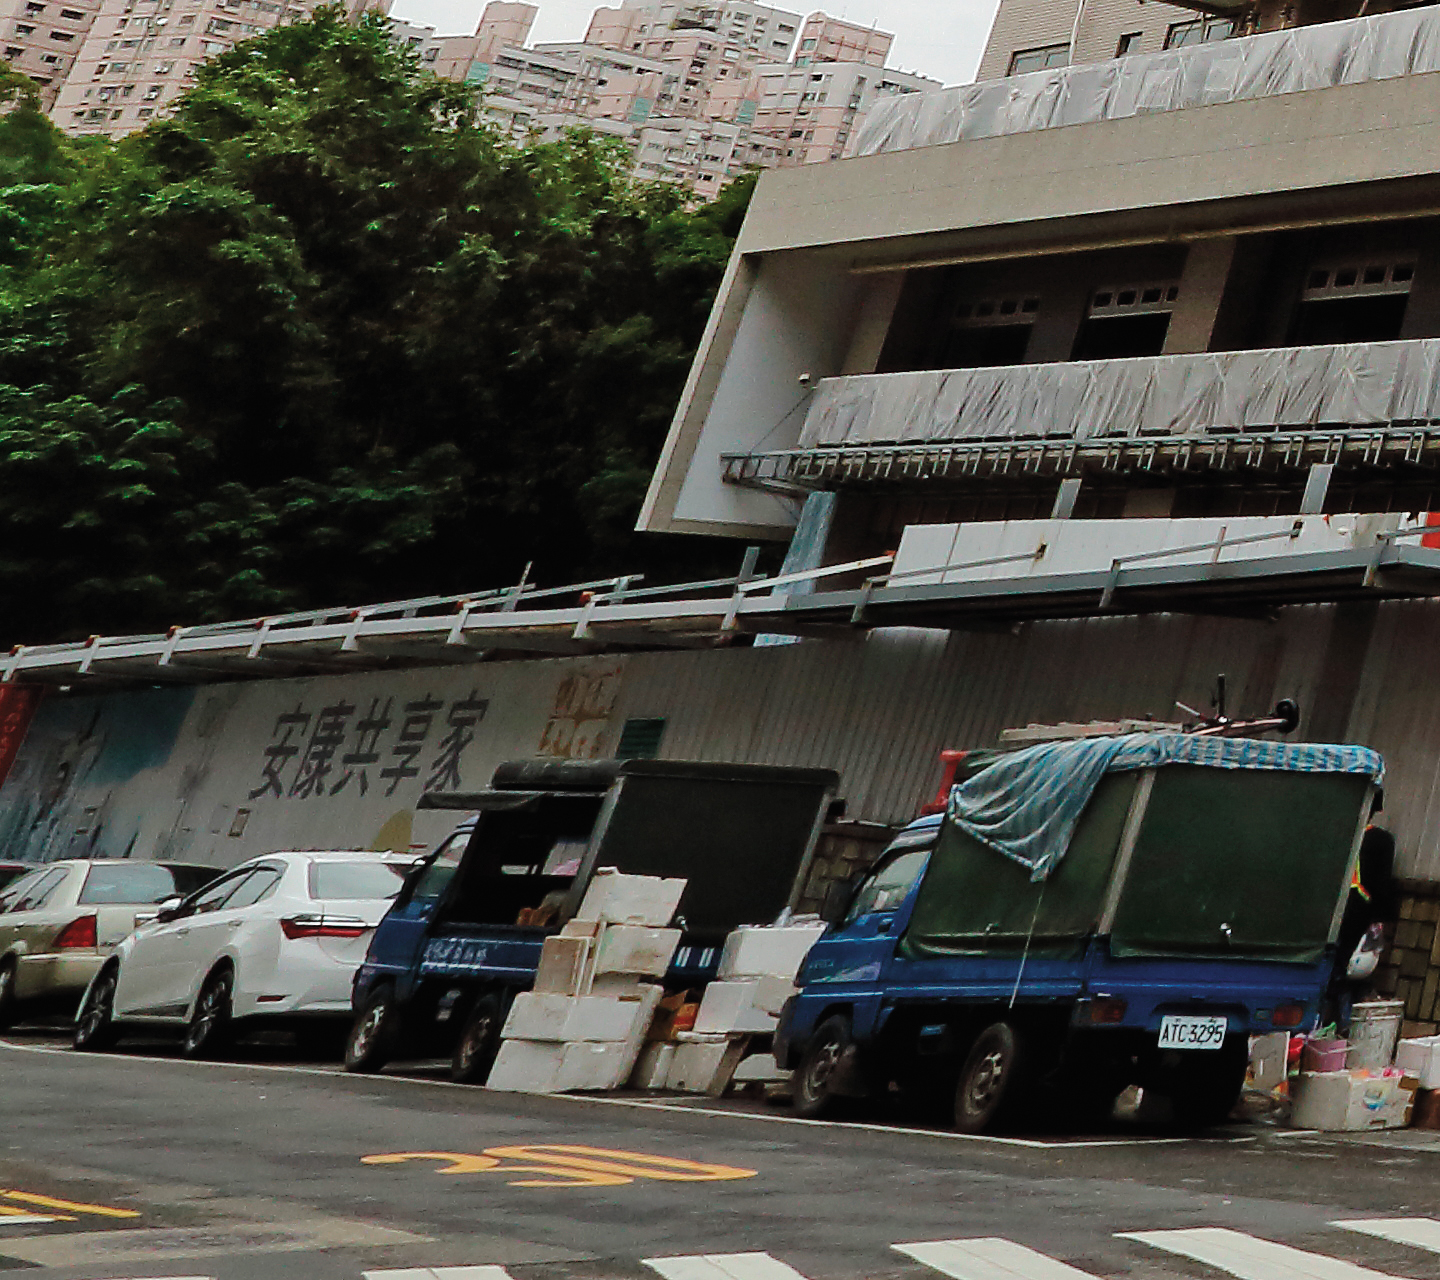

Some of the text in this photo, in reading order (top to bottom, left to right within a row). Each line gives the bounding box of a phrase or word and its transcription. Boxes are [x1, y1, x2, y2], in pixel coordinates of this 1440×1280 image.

[248, 689, 489, 801] 安康共享家
[1161, 1023, 1224, 1043] ATC-3295
